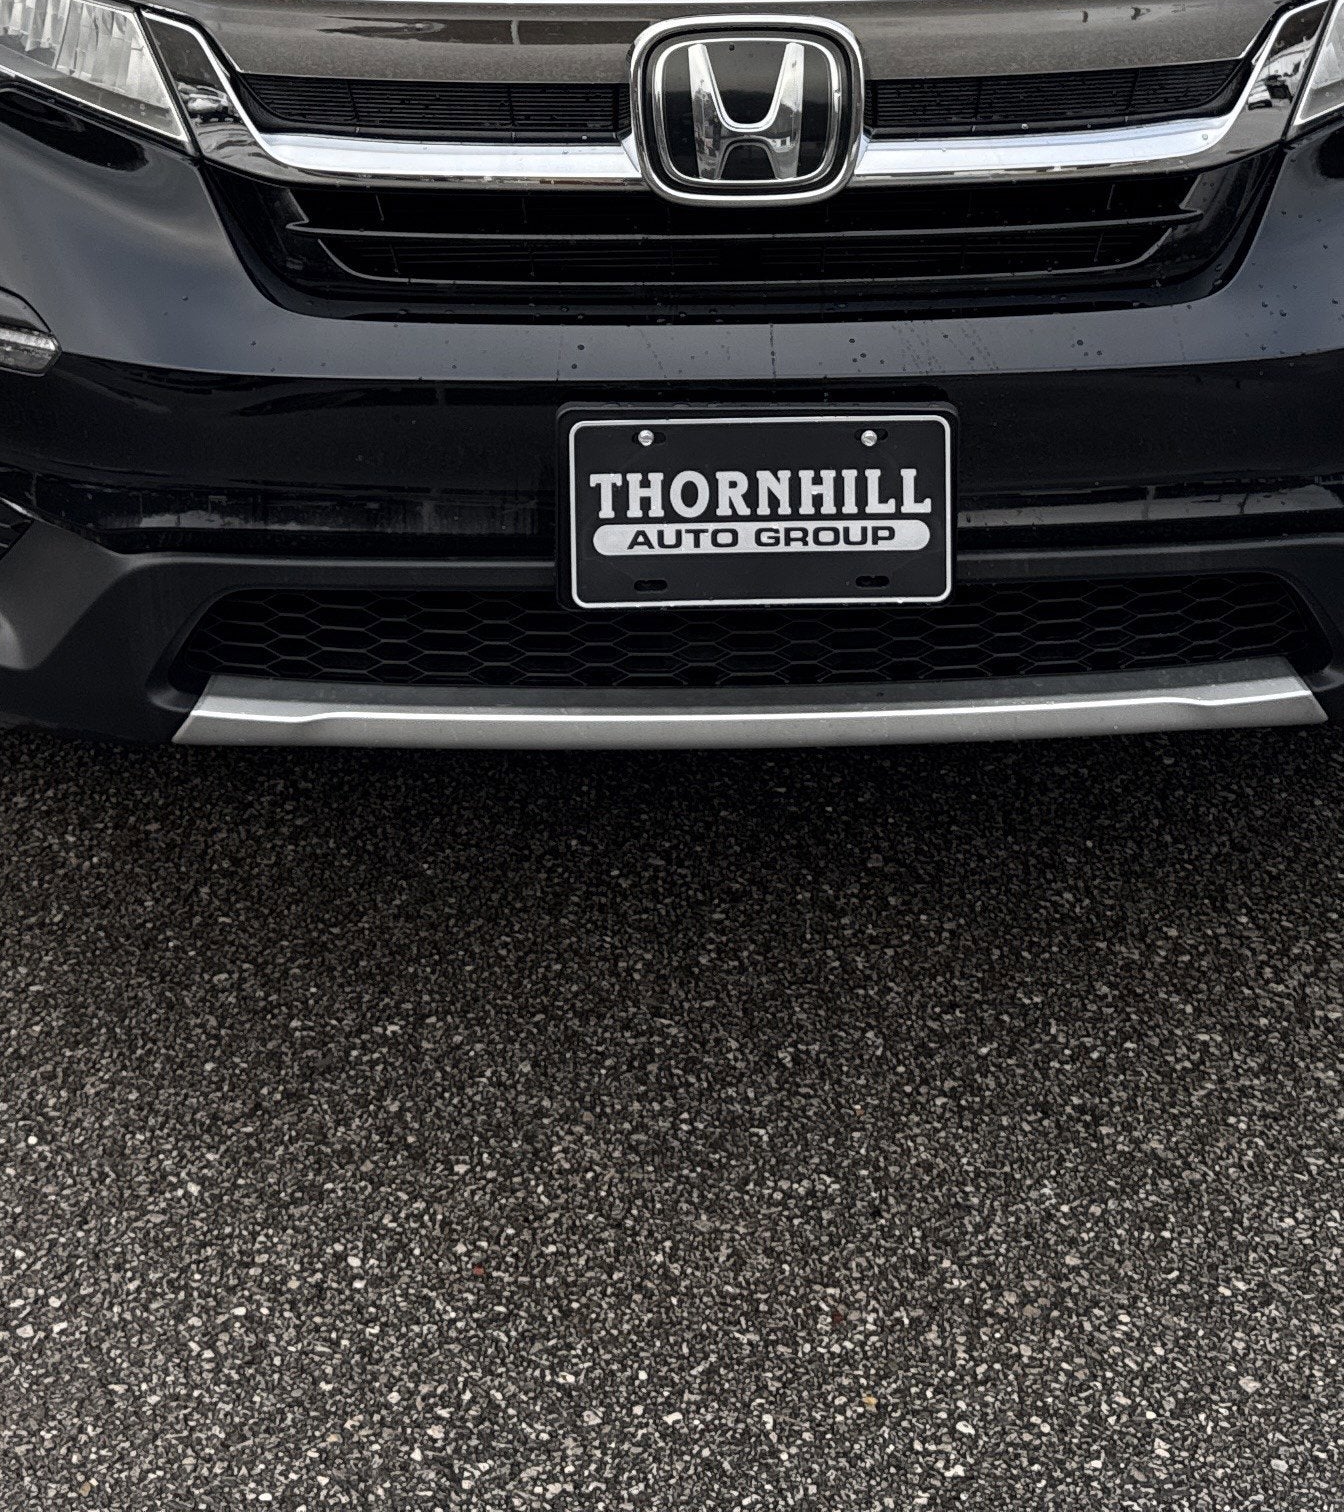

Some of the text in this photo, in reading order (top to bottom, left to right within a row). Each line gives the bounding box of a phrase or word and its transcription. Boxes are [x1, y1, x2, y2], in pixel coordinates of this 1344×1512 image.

[589, 468, 932, 519] THORNHILL
[627, 525, 896, 550] AUTO GROUP
